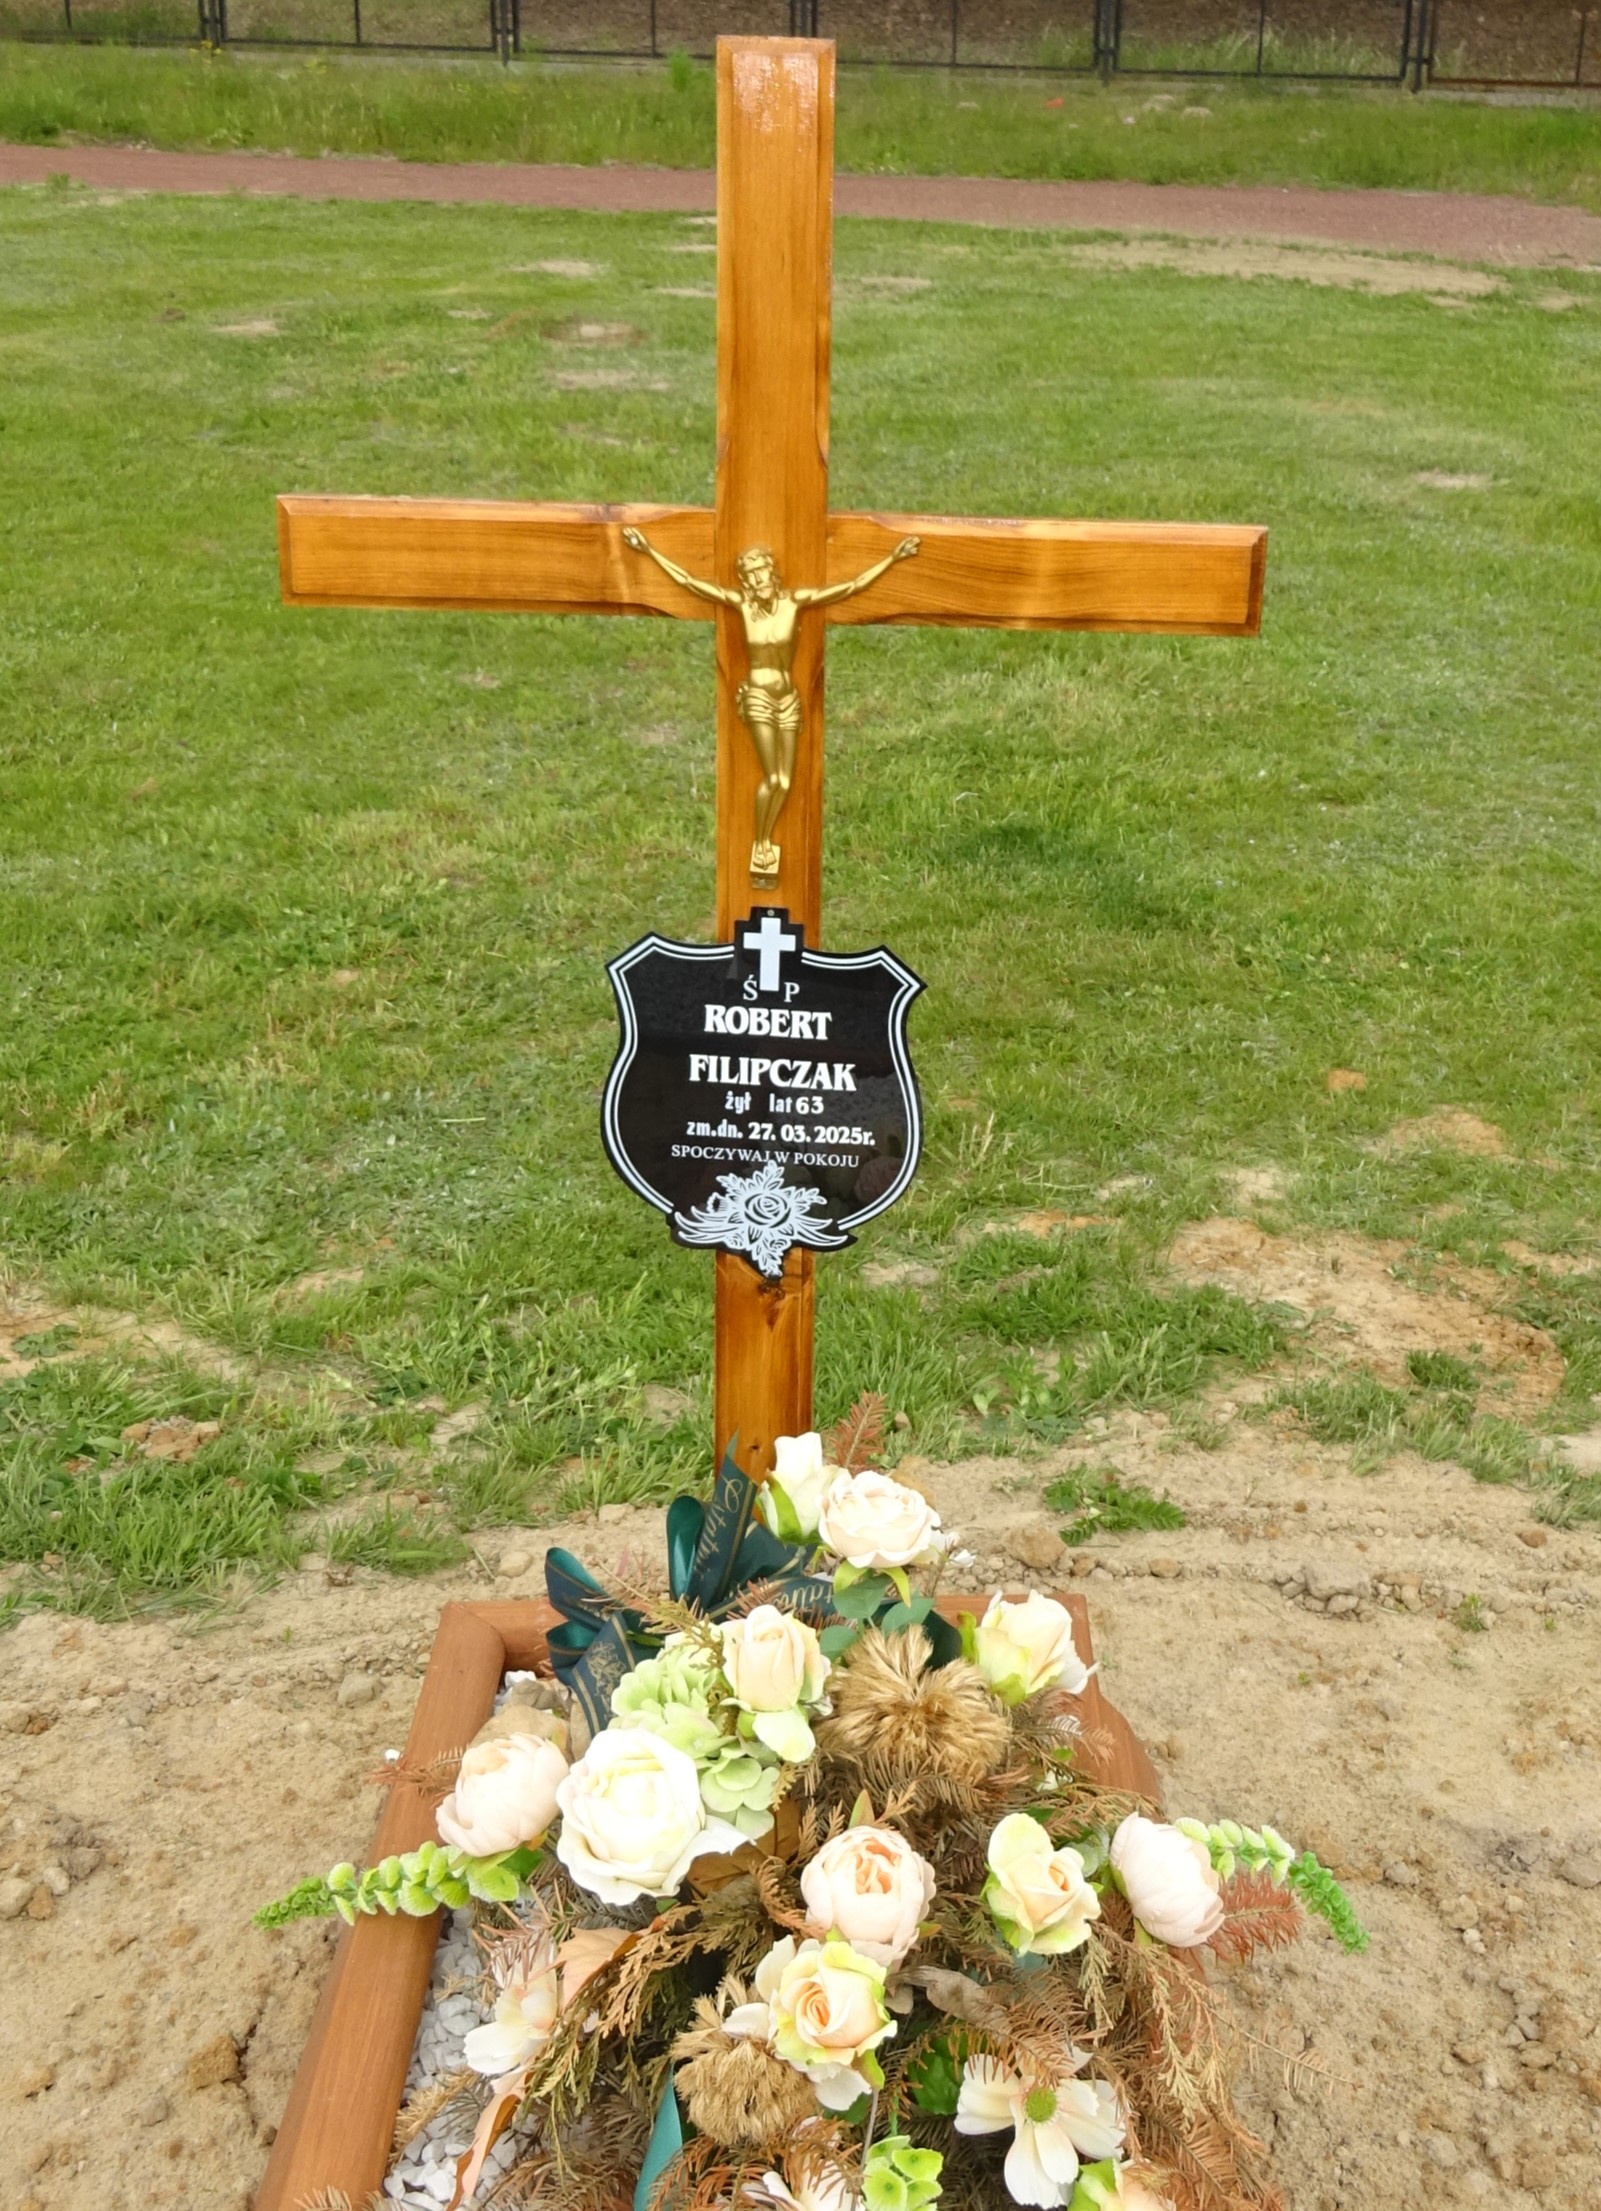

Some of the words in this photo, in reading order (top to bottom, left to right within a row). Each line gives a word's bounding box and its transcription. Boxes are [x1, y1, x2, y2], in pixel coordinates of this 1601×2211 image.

[743, 974, 758, 1001] Ś
[784, 982, 800, 1003] P
[703, 1003, 832, 1040] ROBERT
[688, 1054, 857, 1091] FILIPCZAK
[724, 1090, 752, 1114] żył
[769, 1093, 792, 1114] lat
[795, 1096, 825, 1115] 63
[671, 1144, 770, 1163] SPOCZYWAJ
[774, 1151, 790, 1164] W
[794, 1152, 859, 1168] POKOJU
